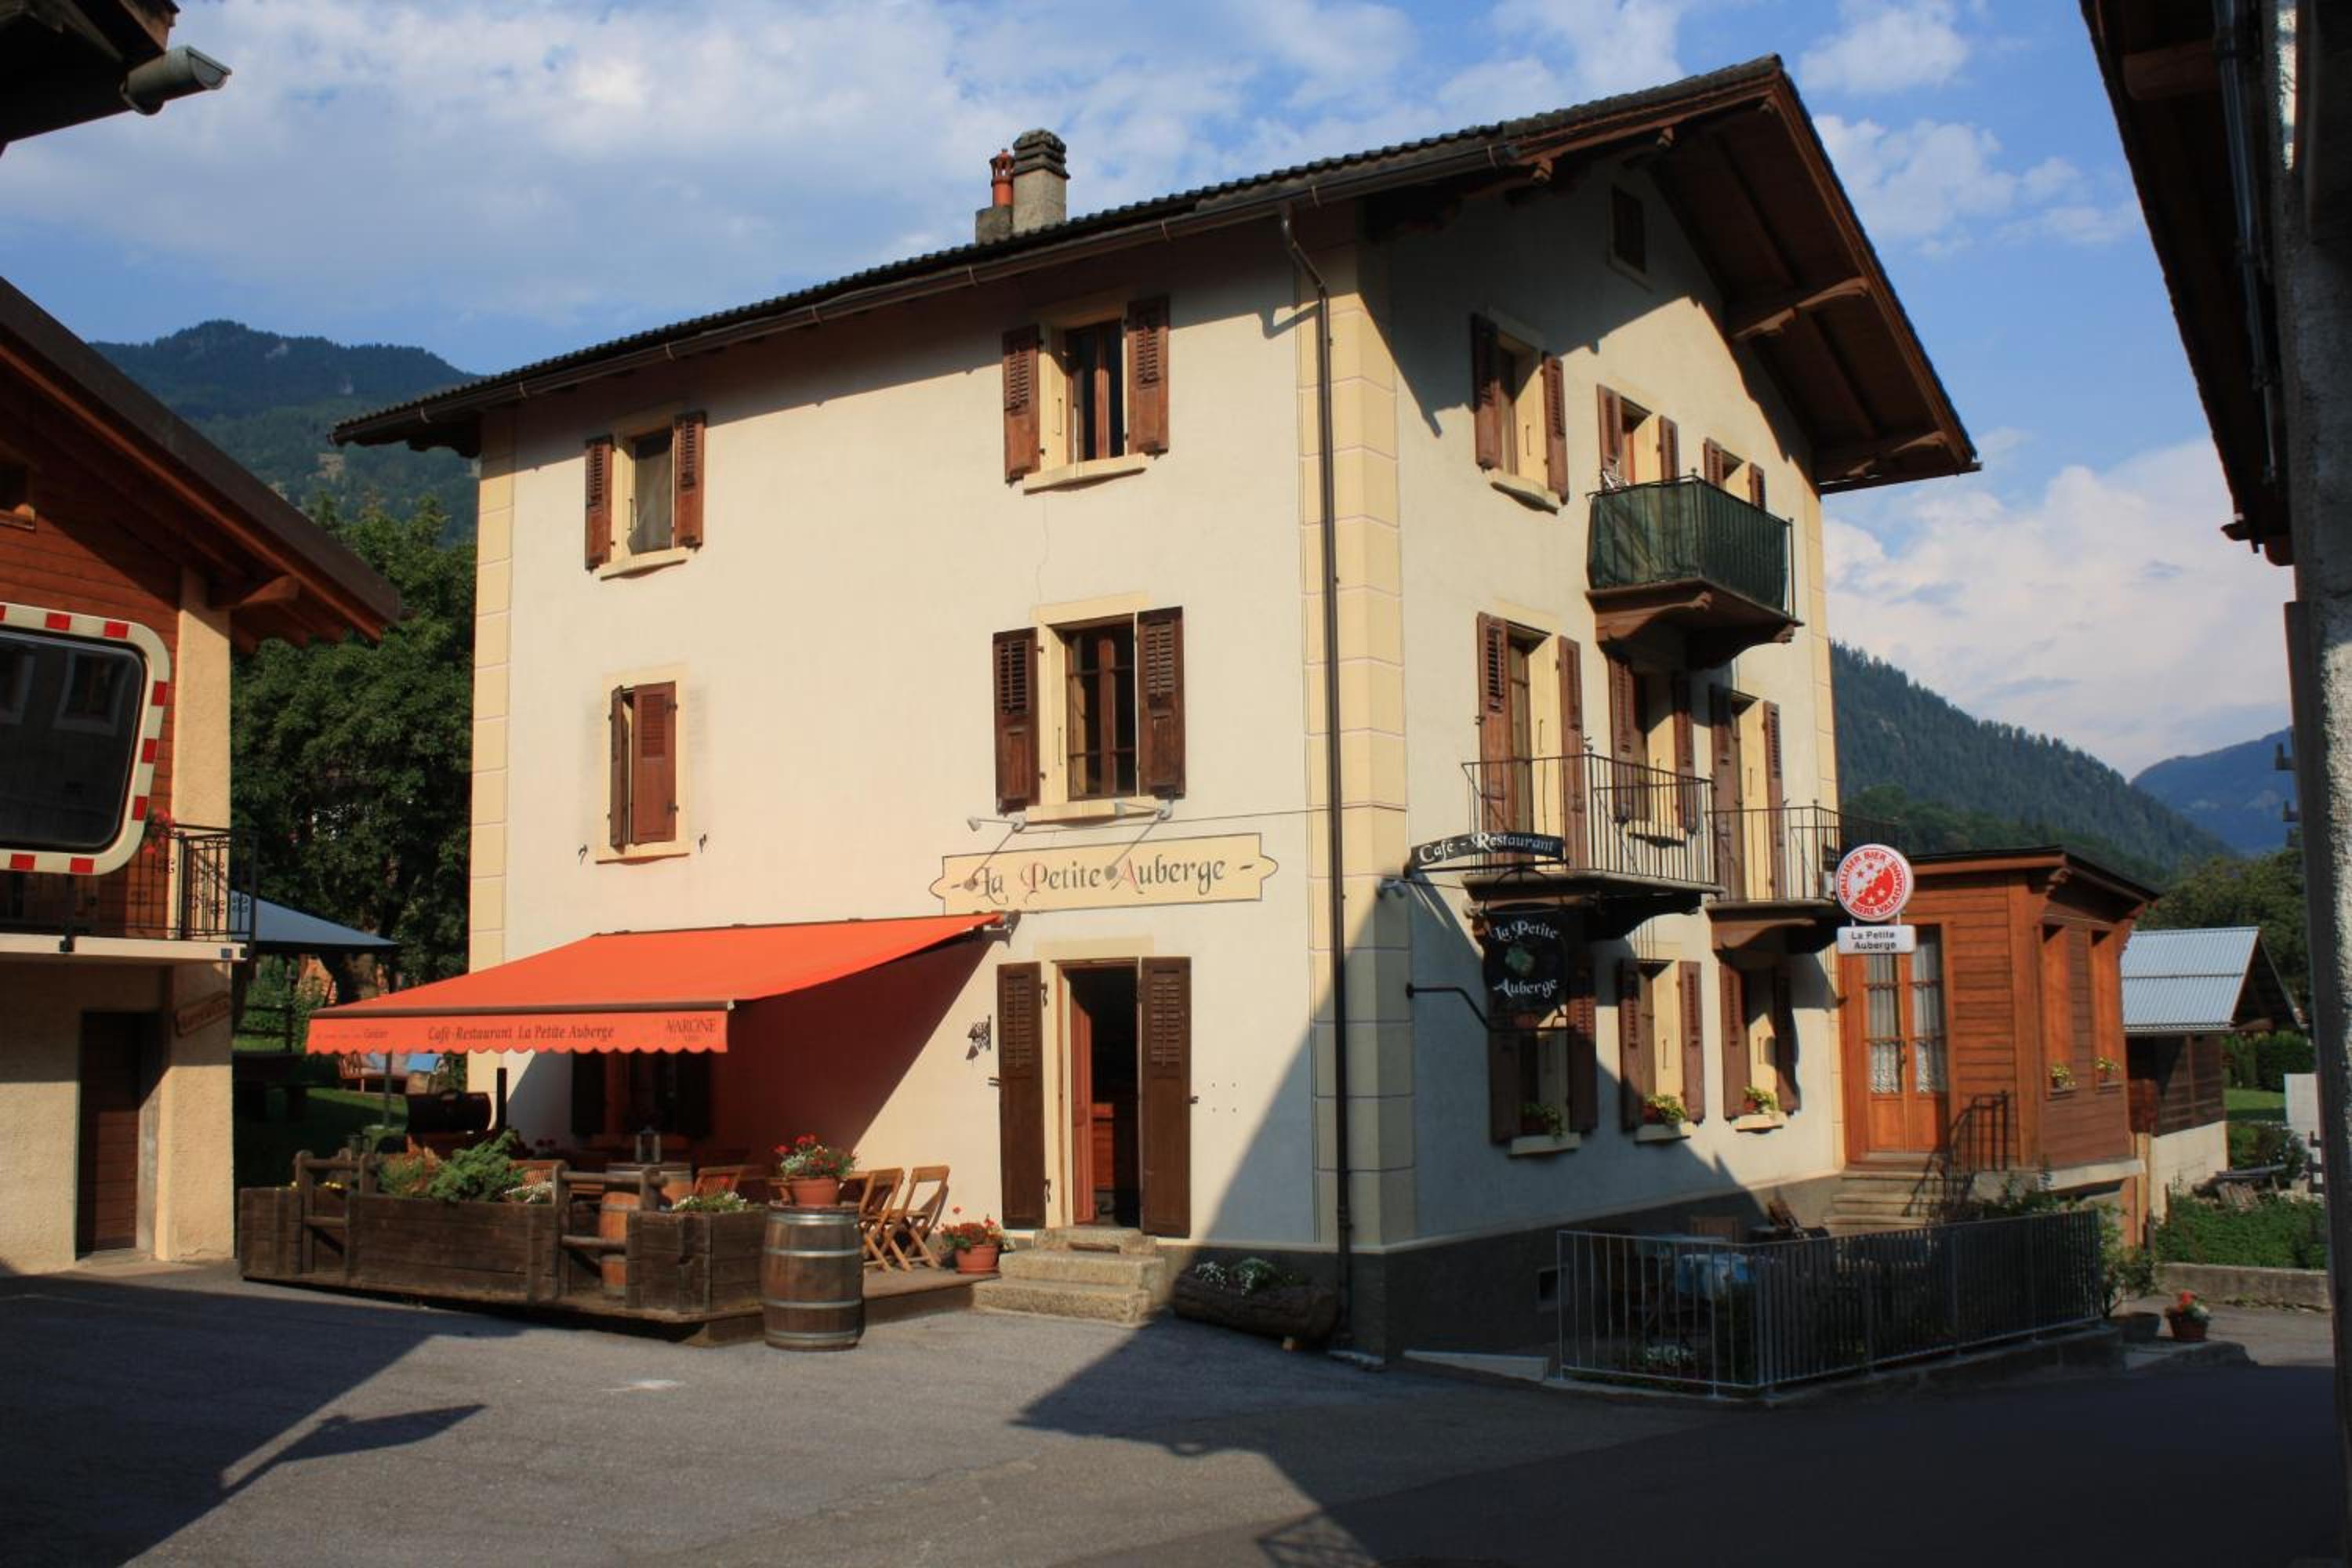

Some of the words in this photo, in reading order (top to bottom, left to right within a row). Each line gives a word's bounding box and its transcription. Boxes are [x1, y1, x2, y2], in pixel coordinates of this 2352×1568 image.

[1471, 831, 1555, 853] Restaurant
[1864, 851, 1886, 862] BIER
[977, 866, 1009, 906] La
[1020, 860, 1102, 904] Petite
[1110, 853, 1226, 895] Auberge
[1491, 925, 1512, 942] La
[1511, 920, 1559, 940] Petite
[1851, 931, 1863, 940] La
[1866, 931, 1895, 939] Petite
[1854, 941, 1896, 950] Auberge
[1493, 978, 1558, 998] Auberge
[517, 1025, 532, 1040] La
[534, 1025, 566, 1040] Petite
[568, 1024, 615, 1042] Auberge
